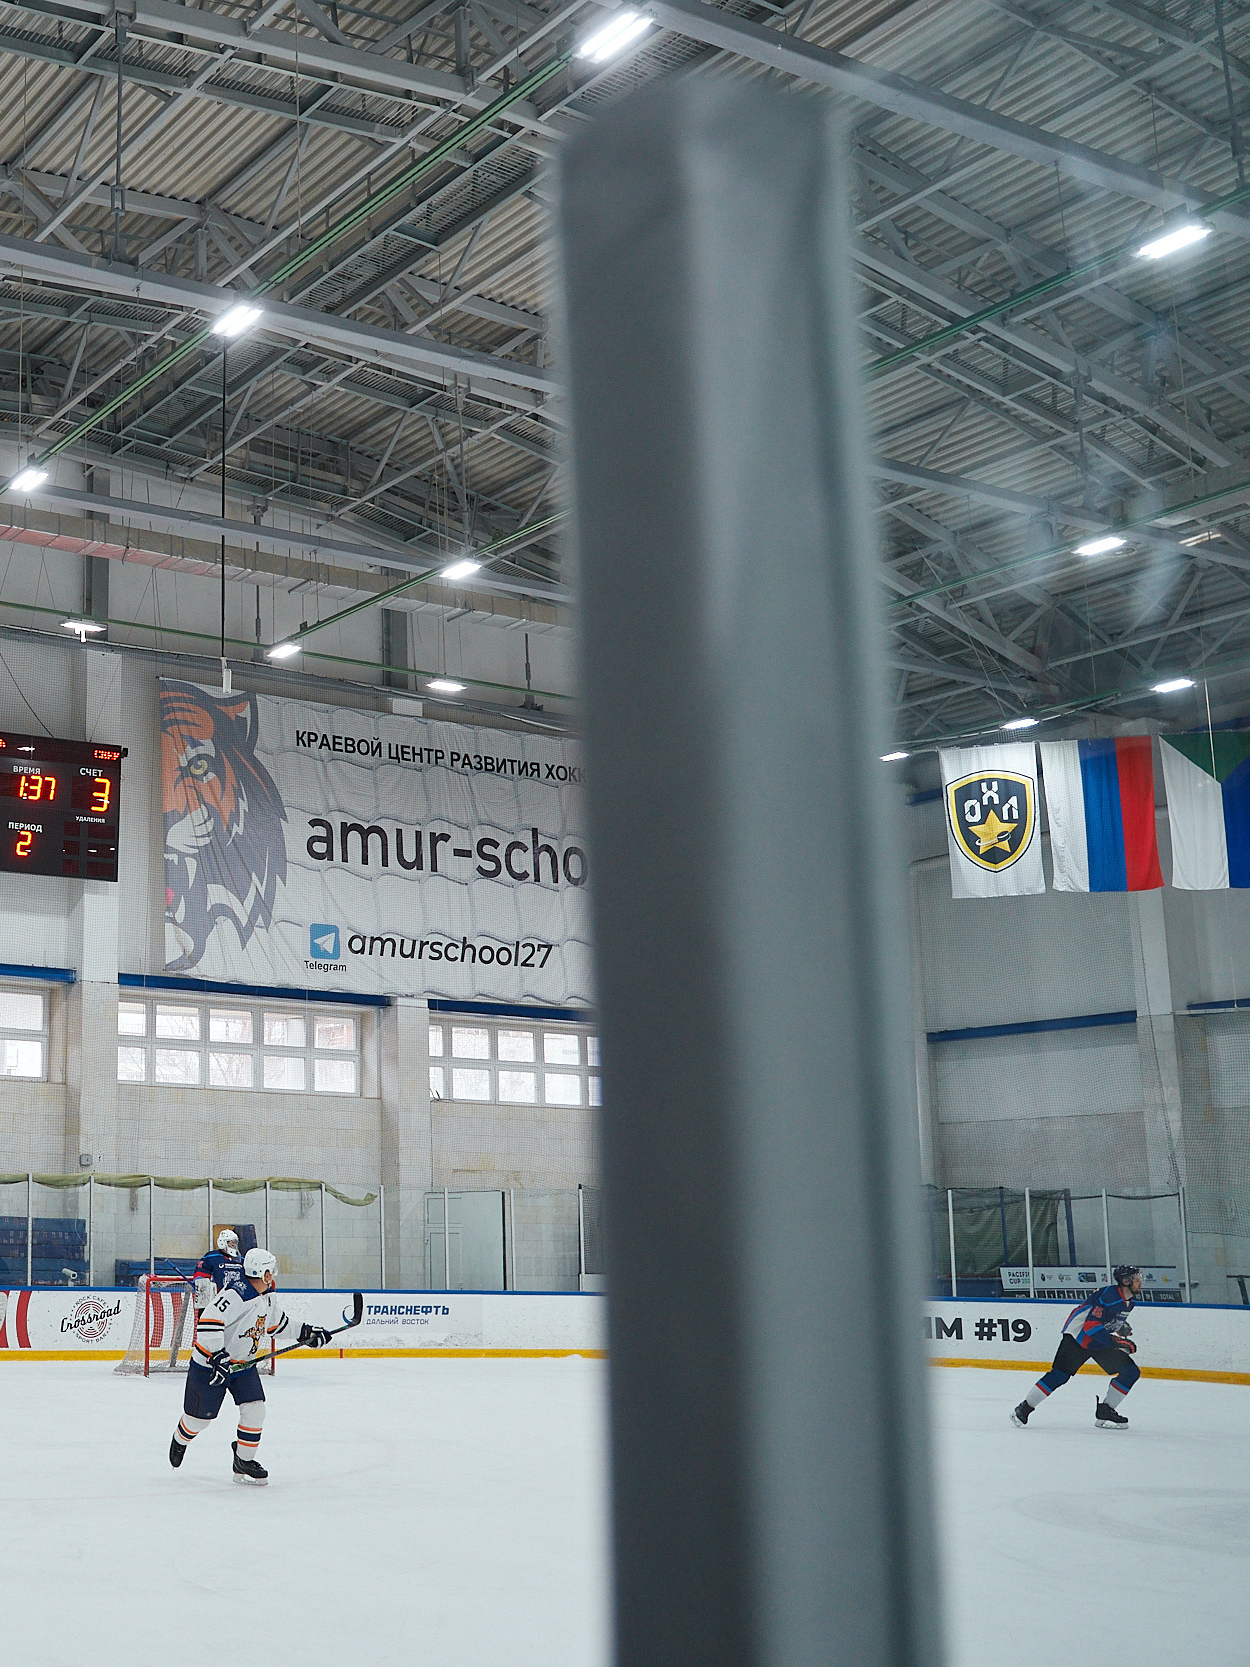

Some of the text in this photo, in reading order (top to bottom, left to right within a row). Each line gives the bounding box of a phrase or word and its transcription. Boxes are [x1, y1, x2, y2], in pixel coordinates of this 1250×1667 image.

[295, 730, 383, 758] КРАЕВОЙ
[388, 743, 445, 767] ЦЕНТР
[450, 753, 540, 779] РАЗВИТИЯ
[13, 765, 41, 775] ВРЕМЯ
[79, 767, 104, 777] СЧЕТ
[90, 777, 111, 812] 3
[8, 821, 43, 833] ПЕРИОД
[75, 815, 106, 824] УДАЛЕНИЯ
[15, 830, 33, 856] 2
[348, 932, 553, 969] amurschool27
[304, 960, 347, 972] Telegram
[213, 1296, 230, 1313] 15
[366, 1305, 450, 1315] ТРАНСНЕФТЬ
[60, 1299, 121, 1333] Crossroad
[366, 1317, 399, 1325] ДАЛЬНИЙ
[974, 1318, 1032, 1342] #19
